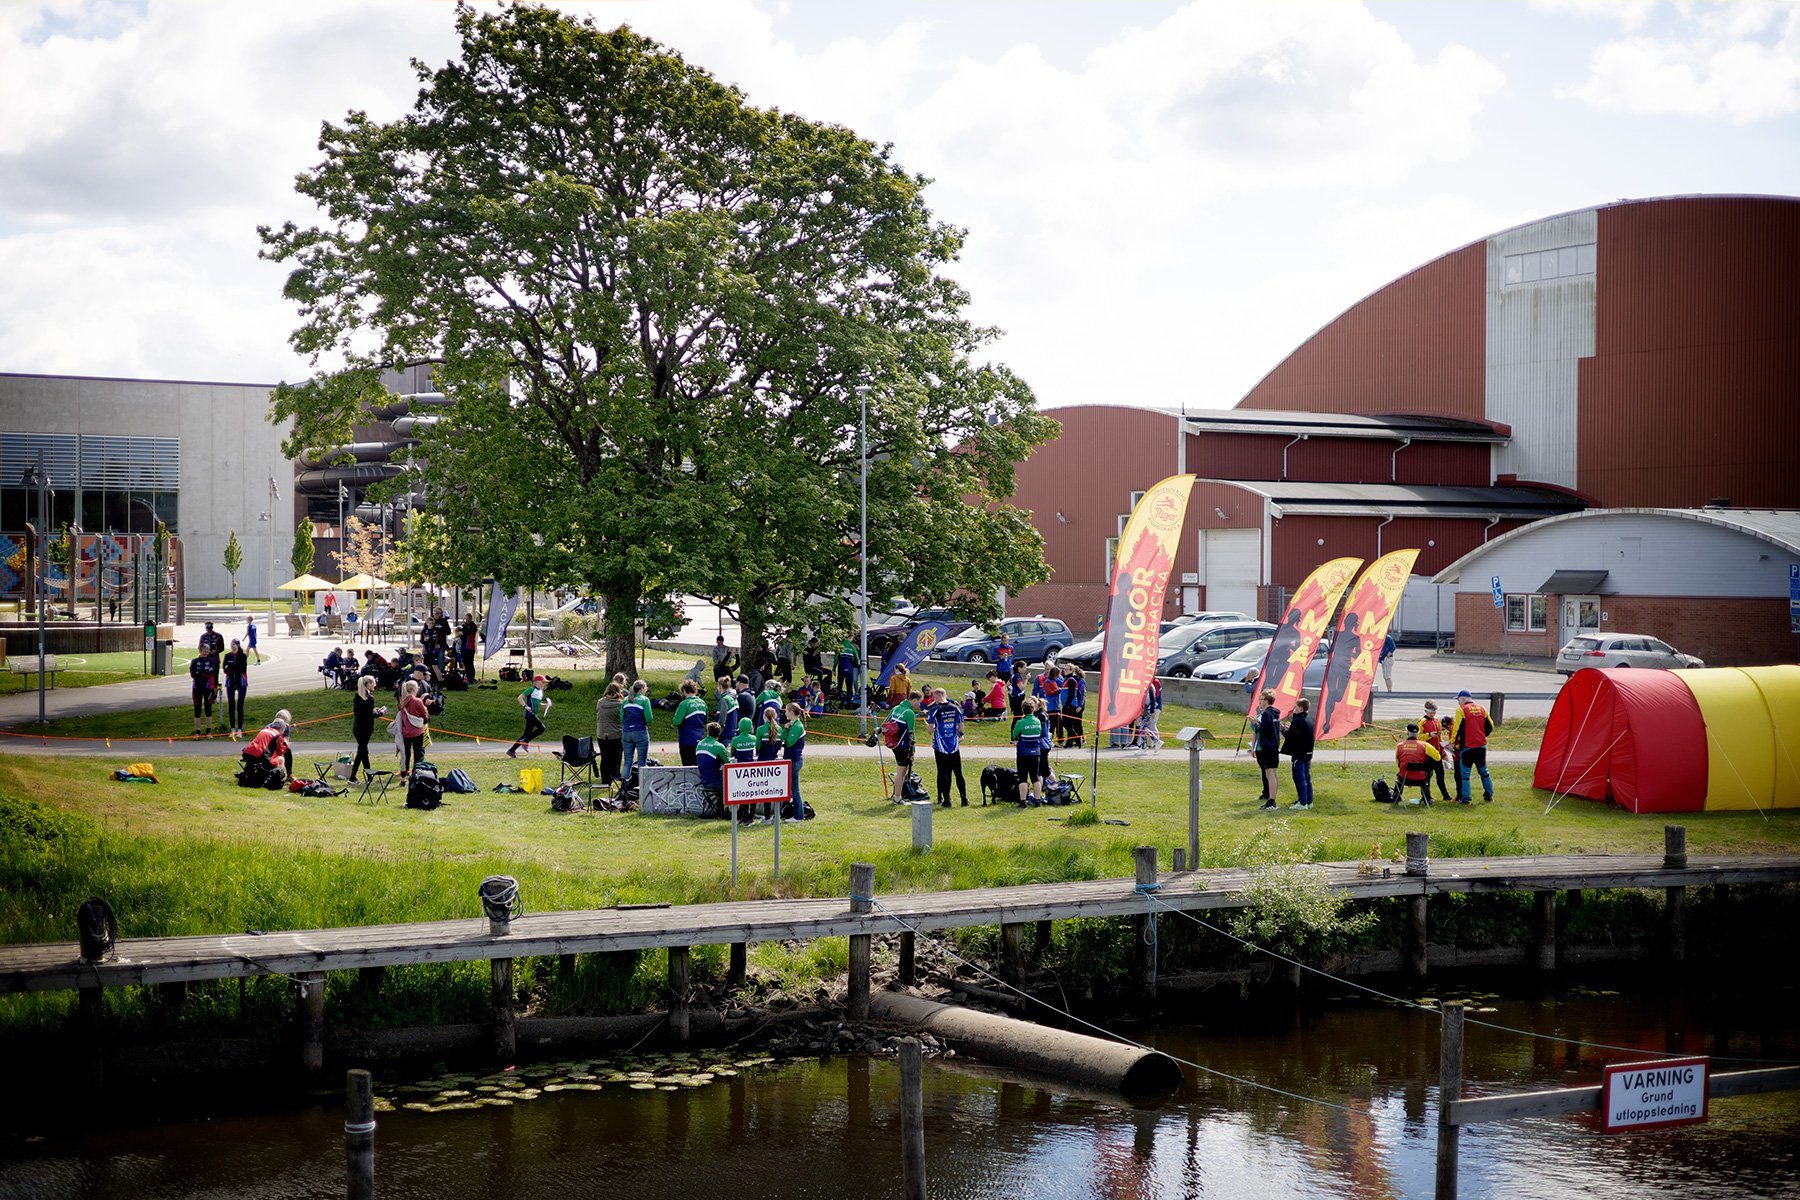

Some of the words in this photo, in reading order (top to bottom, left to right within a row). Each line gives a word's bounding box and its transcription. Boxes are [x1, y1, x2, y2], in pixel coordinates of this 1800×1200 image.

[1155, 506, 1178, 522] Rigor
[1792, 565, 1798, 577] P
[1493, 576, 1499, 588] P
[1122, 567, 1156, 661] RIGOR
[1144, 570, 1170, 691] UNGSBACKA
[1281, 608, 1328, 697] MÅL
[1346, 610, 1392, 708] MÅL
[1119, 668, 1142, 695] IF
[735, 766, 781, 779] VARNING
[732, 787, 784, 798] utloppsledning
[1622, 1068, 1694, 1090] VARNING
[1641, 1089, 1674, 1103] Grund
[1616, 1103, 1697, 1121] utloppsledning
